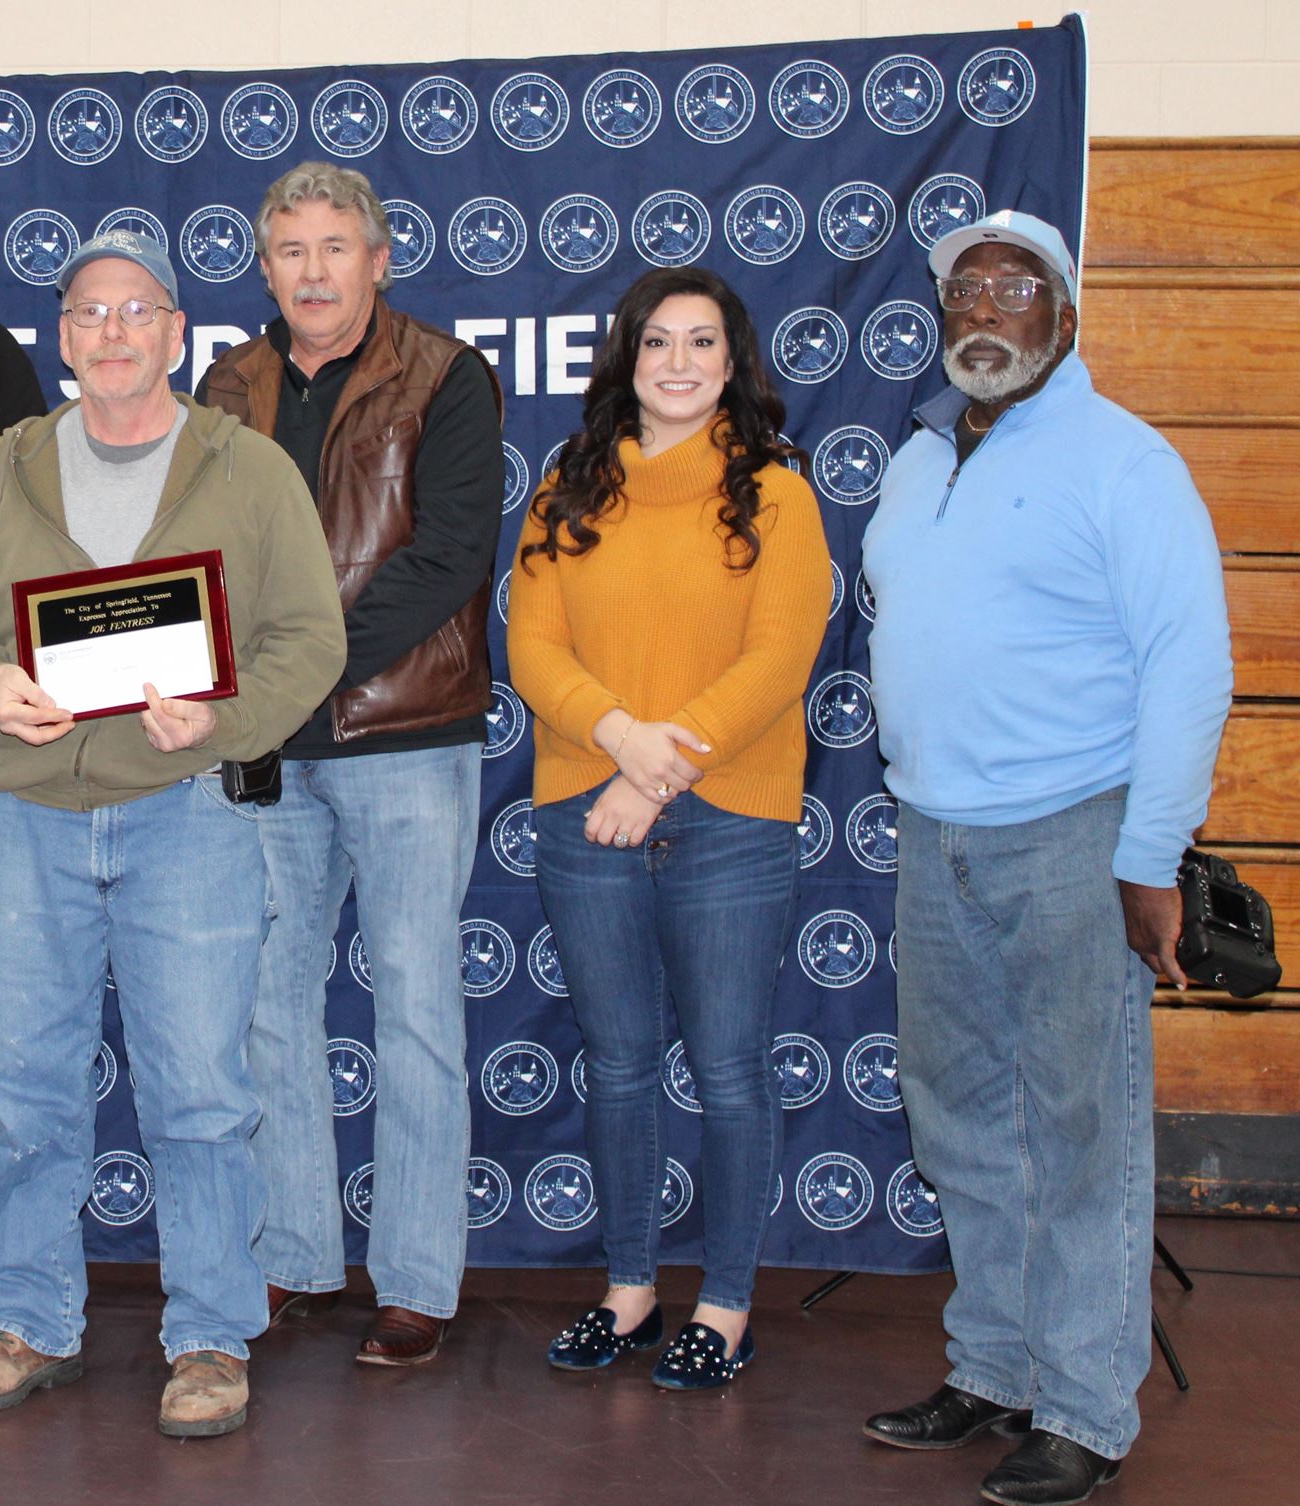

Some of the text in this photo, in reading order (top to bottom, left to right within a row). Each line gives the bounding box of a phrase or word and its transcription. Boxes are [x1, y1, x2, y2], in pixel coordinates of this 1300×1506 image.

[79, 605, 91, 613] City
[143, 592, 172, 602] Tennessee
[79, 613, 107, 622] Expresses
[111, 606, 147, 617] Appreciation
[89, 616, 155, 634] JOE FENTRESS
